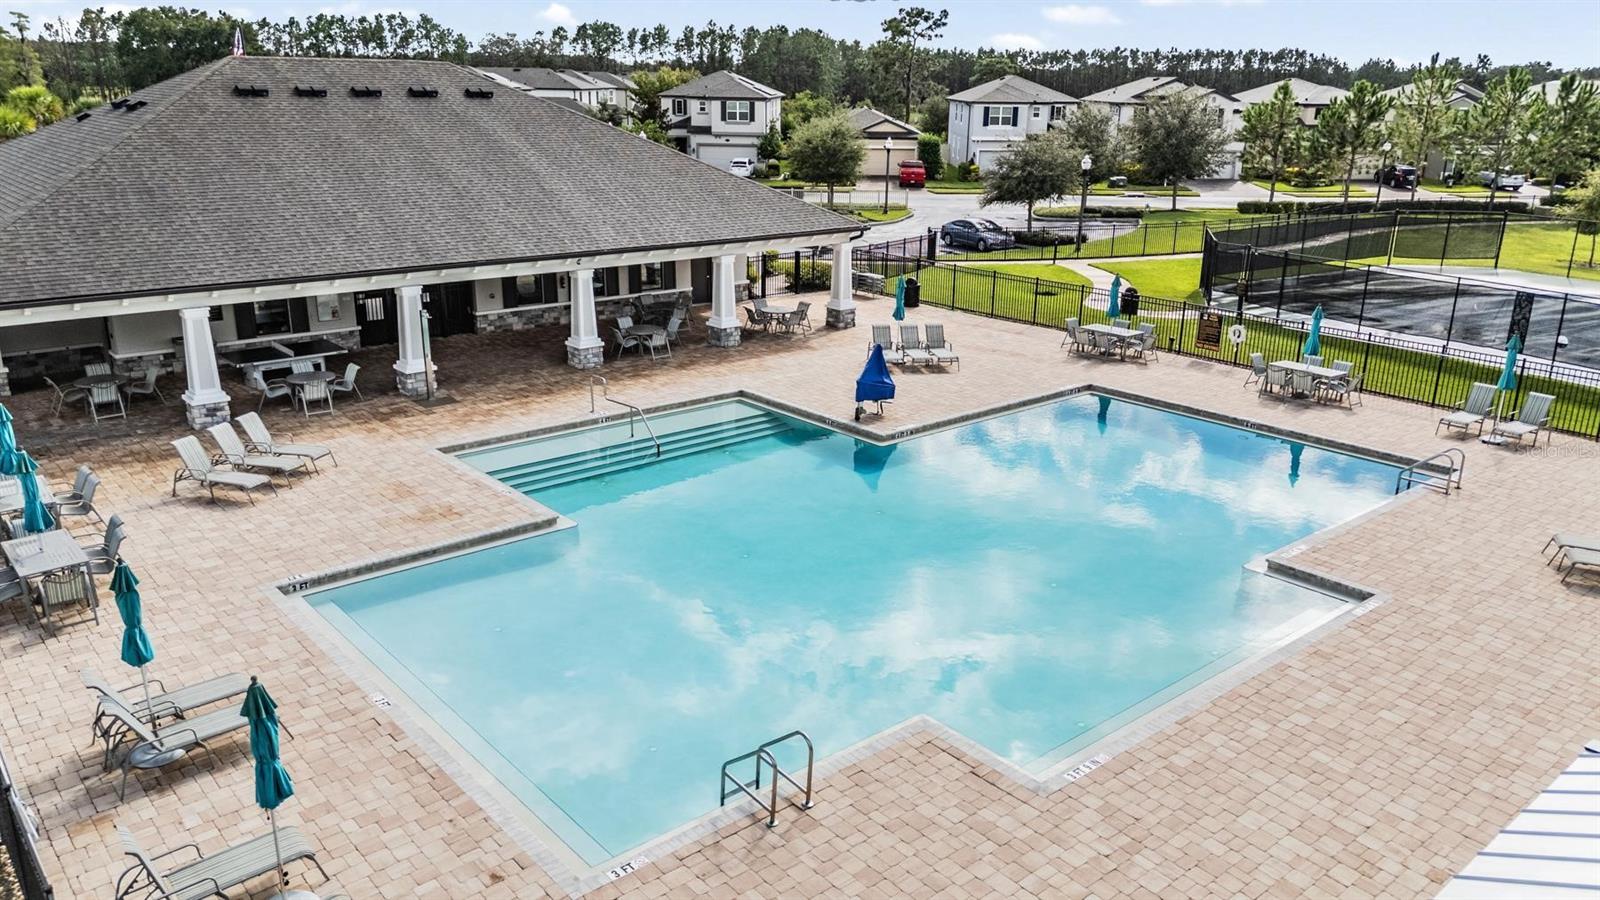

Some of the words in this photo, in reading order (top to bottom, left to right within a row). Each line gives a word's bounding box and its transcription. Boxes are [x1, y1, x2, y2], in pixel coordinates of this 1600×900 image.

[299, 582, 308, 590] FT
[611, 870, 620, 878] 3
[620, 862, 635, 874] FT
